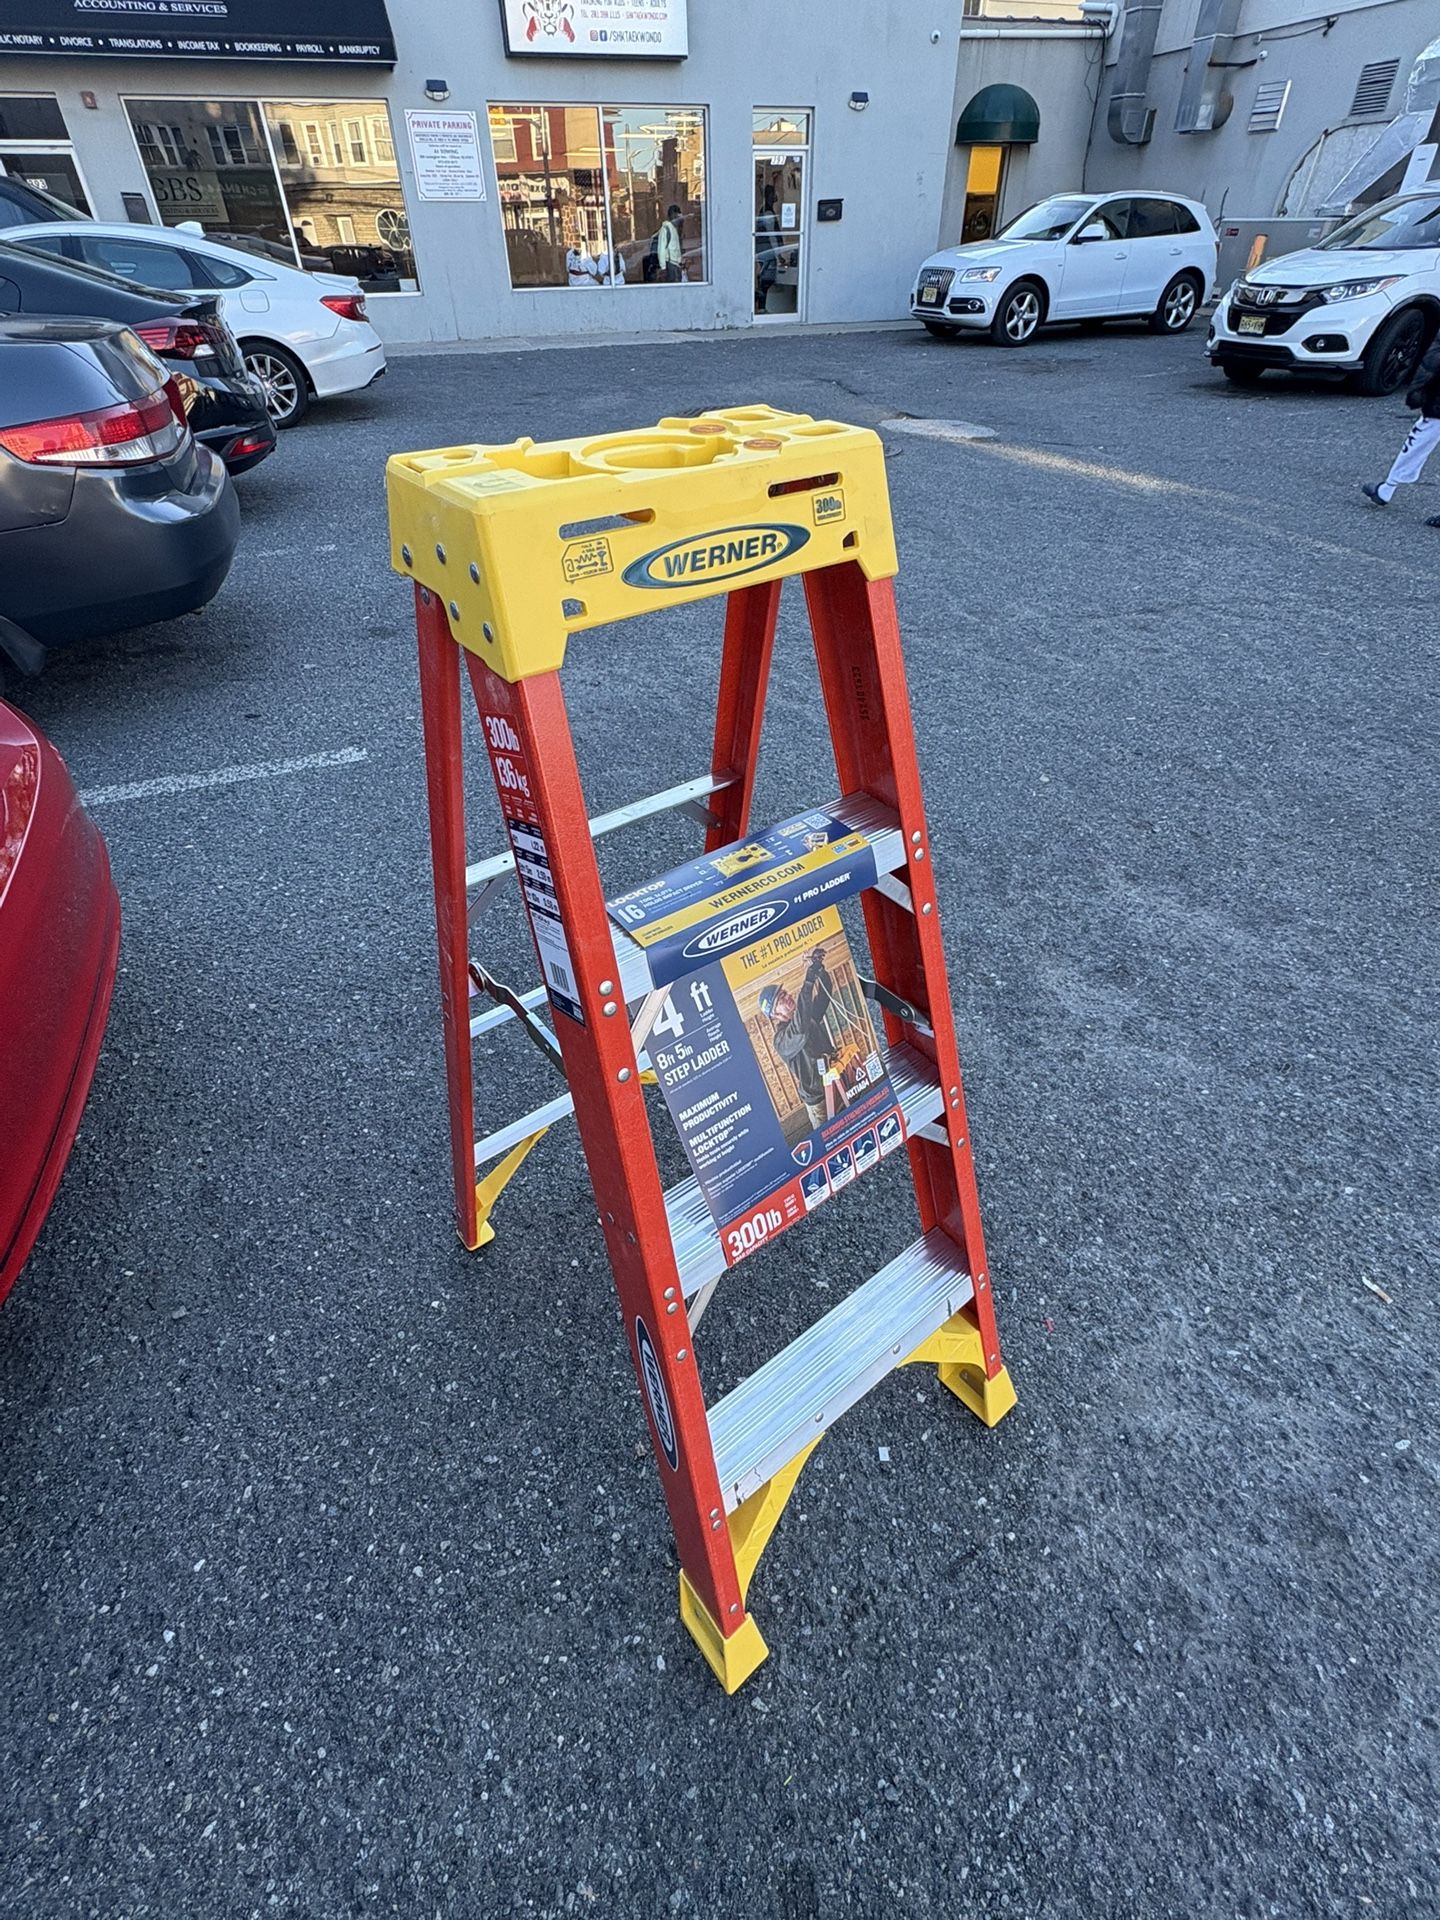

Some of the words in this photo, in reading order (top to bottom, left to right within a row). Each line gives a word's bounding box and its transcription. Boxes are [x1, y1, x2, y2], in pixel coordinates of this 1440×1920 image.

[74, 0, 156, 10] ACCOUNTING
[158, 3, 168, 12] &
[171, 3, 228, 14] SERVICES
[12, 34, 43, 45] NOTARY
[60, 37, 94, 47] DIVORCE
[109, 38, 164, 49] TRANSLATIONS
[177, 41, 206, 50] INCOME
[206, 41, 220, 50] TAX
[234, 42, 282, 52] BOOKKEEPING
[296, 44, 325, 53] PAYROLL
[338, 45, 381, 55] BANKRUPTCY
[411, 120, 441, 129] PRIVATE
[442, 121, 472, 129] PARKING
[664, 533, 778, 577] WERNER
[485, 716, 521, 752] 300lb
[607, 880, 666, 908] LOCKTOP
[709, 863, 805, 908] WERNERCO.COM
[793, 896, 803, 904] #1
[802, 887, 819, 901] PRO
[820, 872, 851, 892] LADDER
[617, 904, 646, 924] 16
[706, 909, 769, 947] WERNER
[740, 949, 760, 969] THE
[760, 943, 774, 960] #1
[773, 932, 793, 952] PRO
[791, 915, 825, 941] LADDER
[652, 994, 685, 1037] 4
[690, 981, 713, 1012] ft
[656, 1053, 675, 1070] 8ft
[674, 1043, 694, 1060] 5in
[664, 1063, 690, 1086] STEP
[690, 1040, 731, 1071] LADDER
[679, 1091, 720, 1121] MAXIMUM
[682, 1091, 739, 1131] PRODUCTIVITY
[688, 1103, 752, 1147] MULTIFUNCTION
[728, 1208, 783, 1257] 300lb
